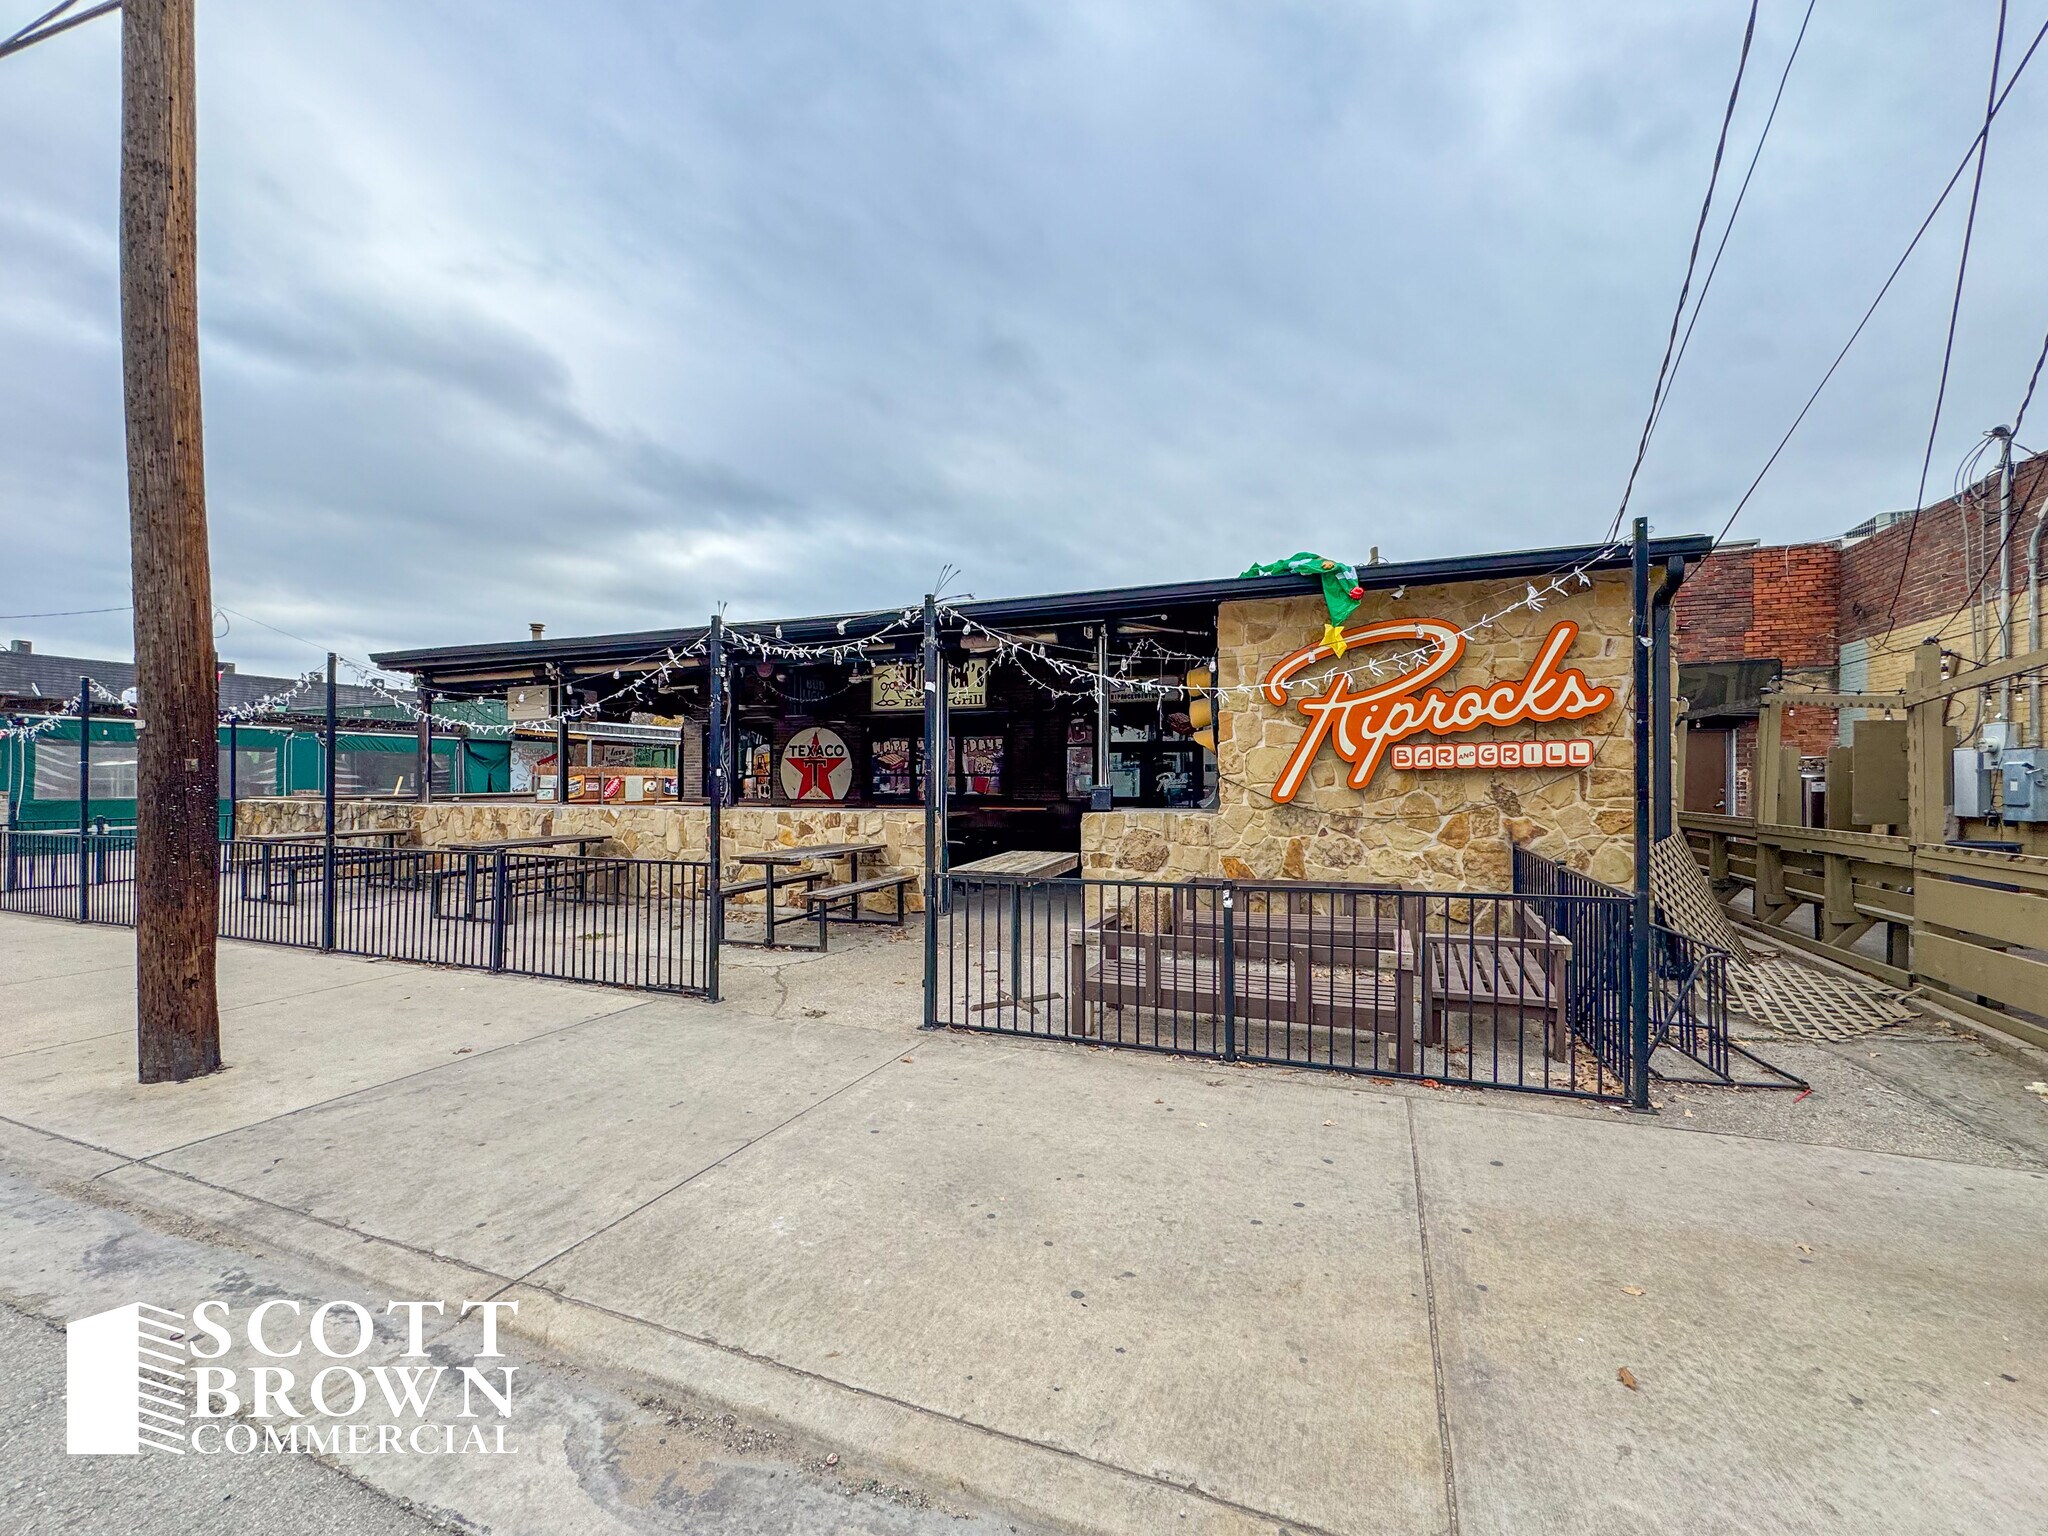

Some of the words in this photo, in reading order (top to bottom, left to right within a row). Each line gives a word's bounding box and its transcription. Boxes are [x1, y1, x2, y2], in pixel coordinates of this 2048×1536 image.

[953, 694, 984, 706] Grill
[1269, 622, 1606, 797] Riprocks
[789, 744, 844, 757] TEXACO
[1396, 748, 1452, 764] BAR
[1458, 750, 1475, 760] AND
[1481, 745, 1586, 763] GRILL
[803, 759, 827, 787] T
